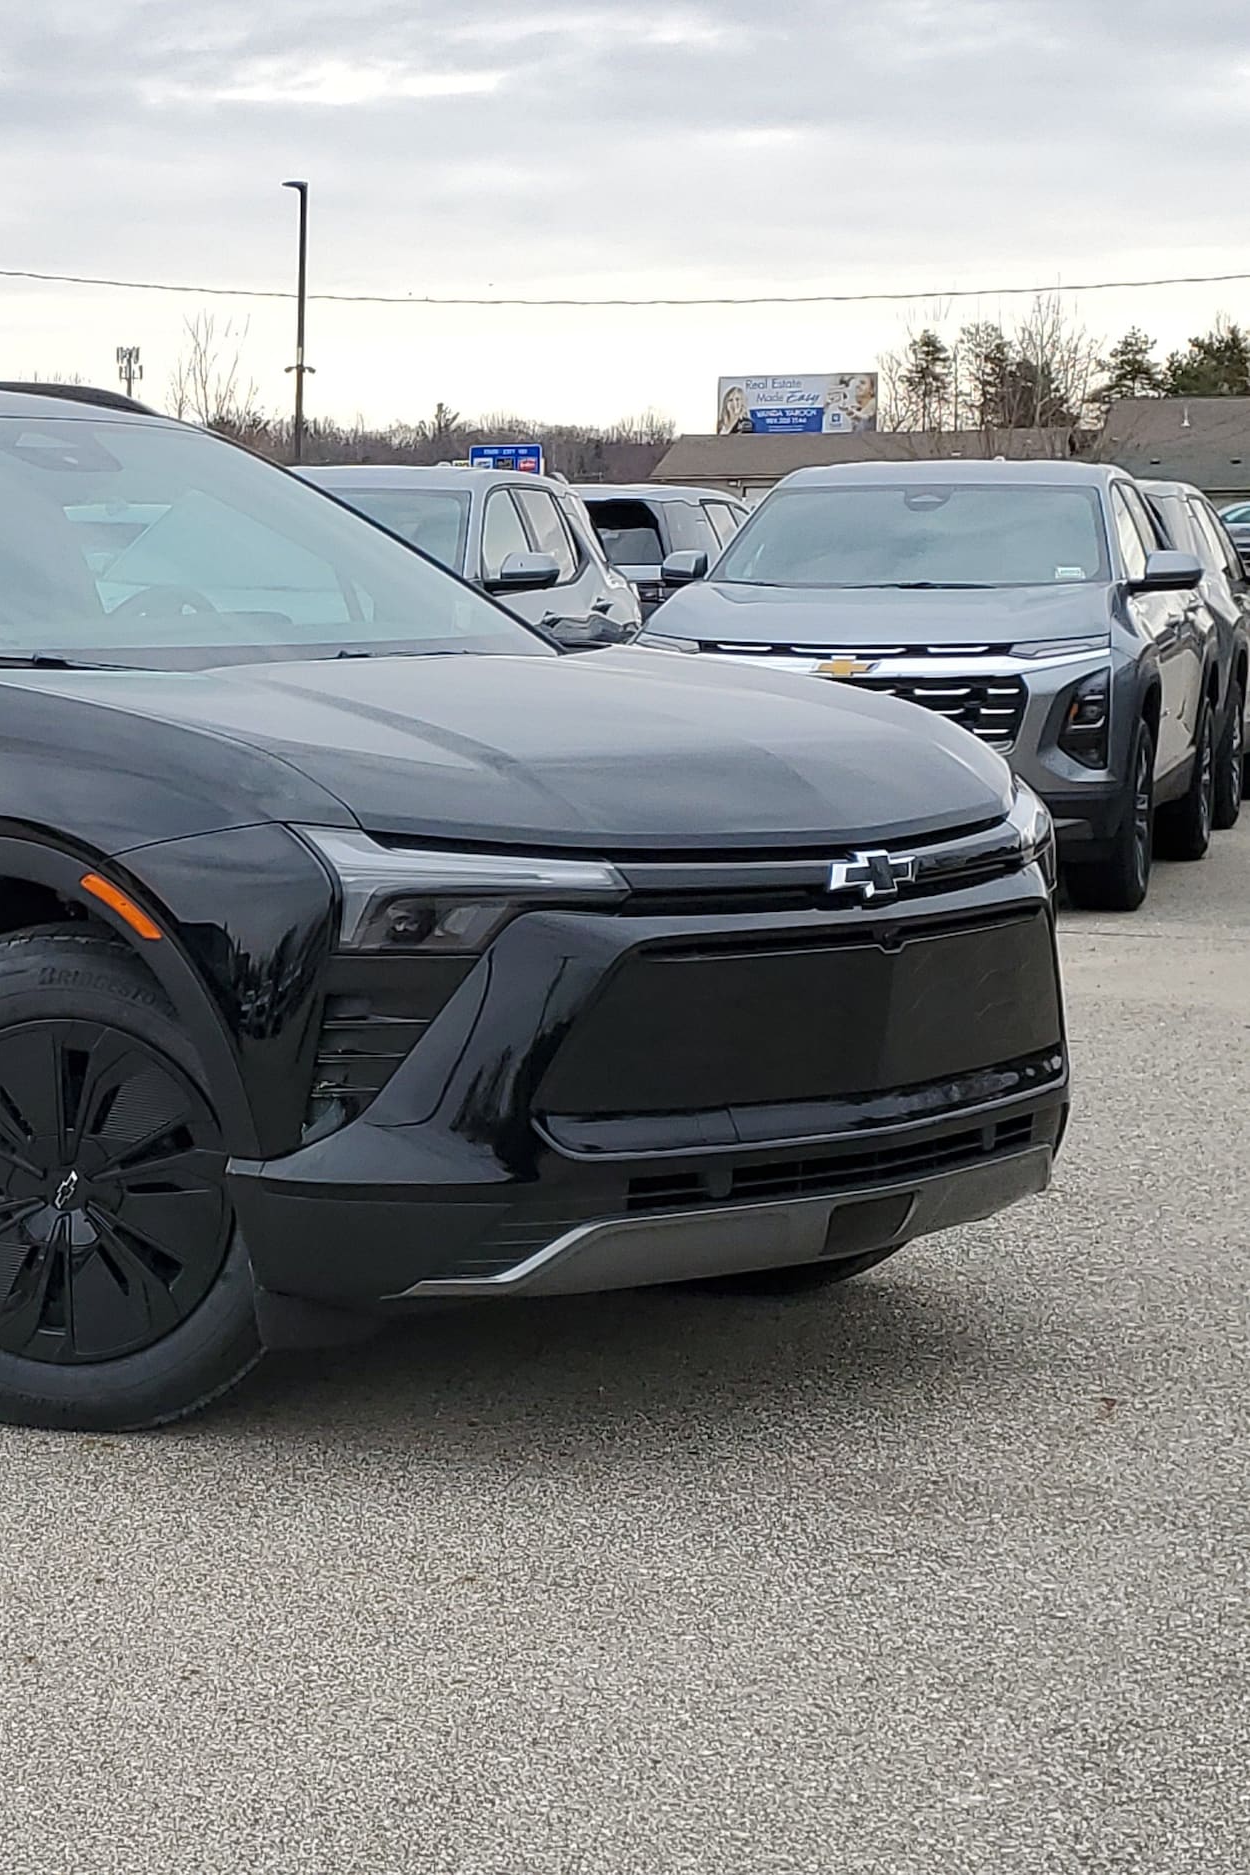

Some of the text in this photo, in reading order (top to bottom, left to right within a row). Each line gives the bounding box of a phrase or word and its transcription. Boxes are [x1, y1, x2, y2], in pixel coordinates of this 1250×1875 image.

[745, 378, 802, 391] Real Estate
[757, 390, 820, 405] Made Easy
